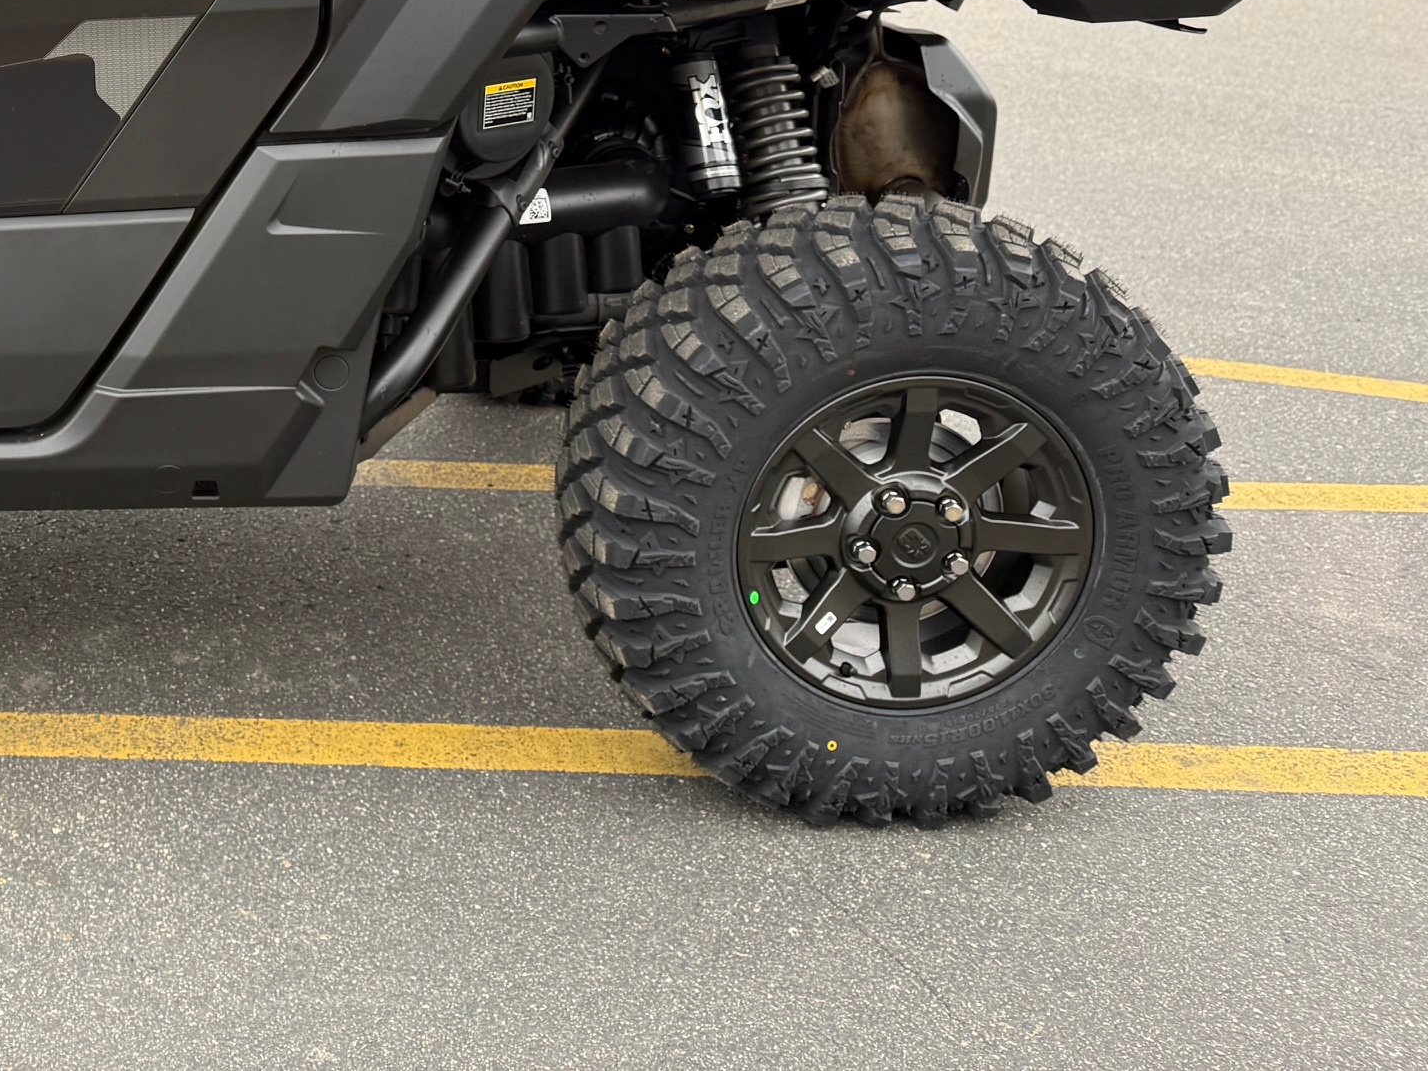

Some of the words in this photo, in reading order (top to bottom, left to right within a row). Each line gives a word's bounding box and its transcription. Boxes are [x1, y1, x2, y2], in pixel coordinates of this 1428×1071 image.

[503, 82, 524, 91] CAUTION
[688, 73, 732, 147] FOX
[1095, 443, 1136, 502] PRO
[1101, 508, 1140, 611] ARMOR
